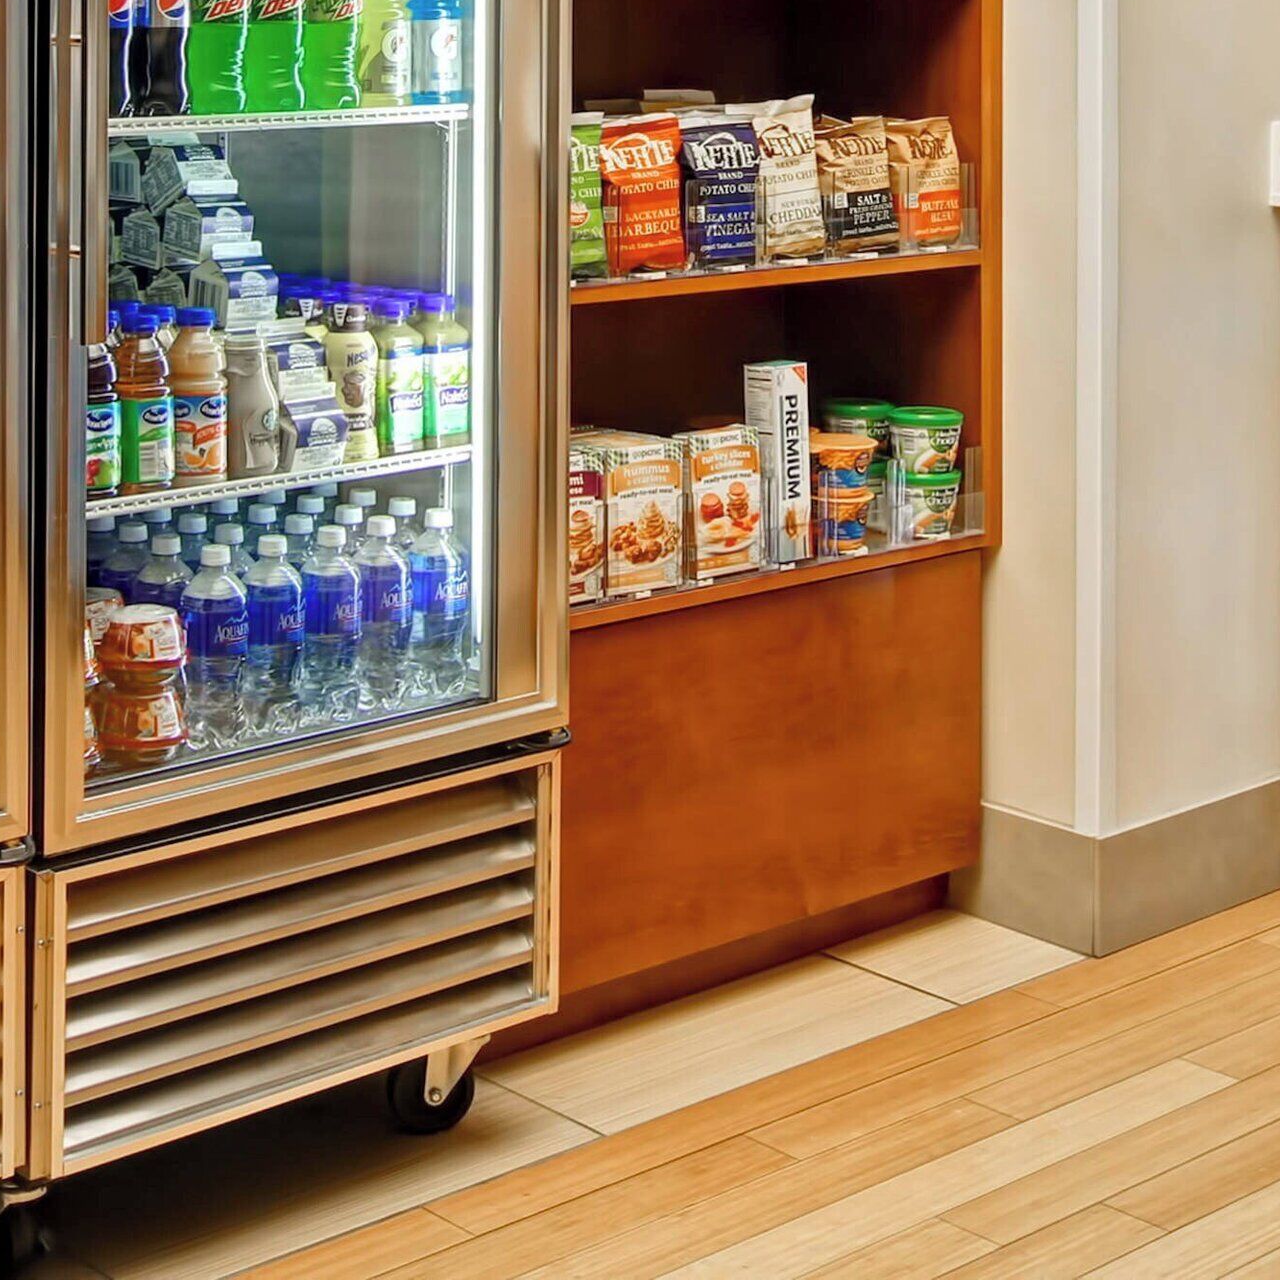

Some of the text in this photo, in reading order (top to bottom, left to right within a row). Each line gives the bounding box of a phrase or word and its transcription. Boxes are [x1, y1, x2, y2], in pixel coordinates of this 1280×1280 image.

[599, 139, 677, 175] KETTLE
[691, 141, 758, 172] KETTLE
[700, 183, 737, 196] POTATO
[857, 193, 880, 206] SALT
[706, 210, 749, 223] SEA SALT
[854, 209, 890, 225] PEPPER
[784, 393, 802, 501] PREMIUM
[729, 450, 752, 462] slices
[623, 464, 670, 478] hummus
[703, 471, 753, 484] ready-to-eat meal
[619, 487, 674, 500] ready-to-eat meal
